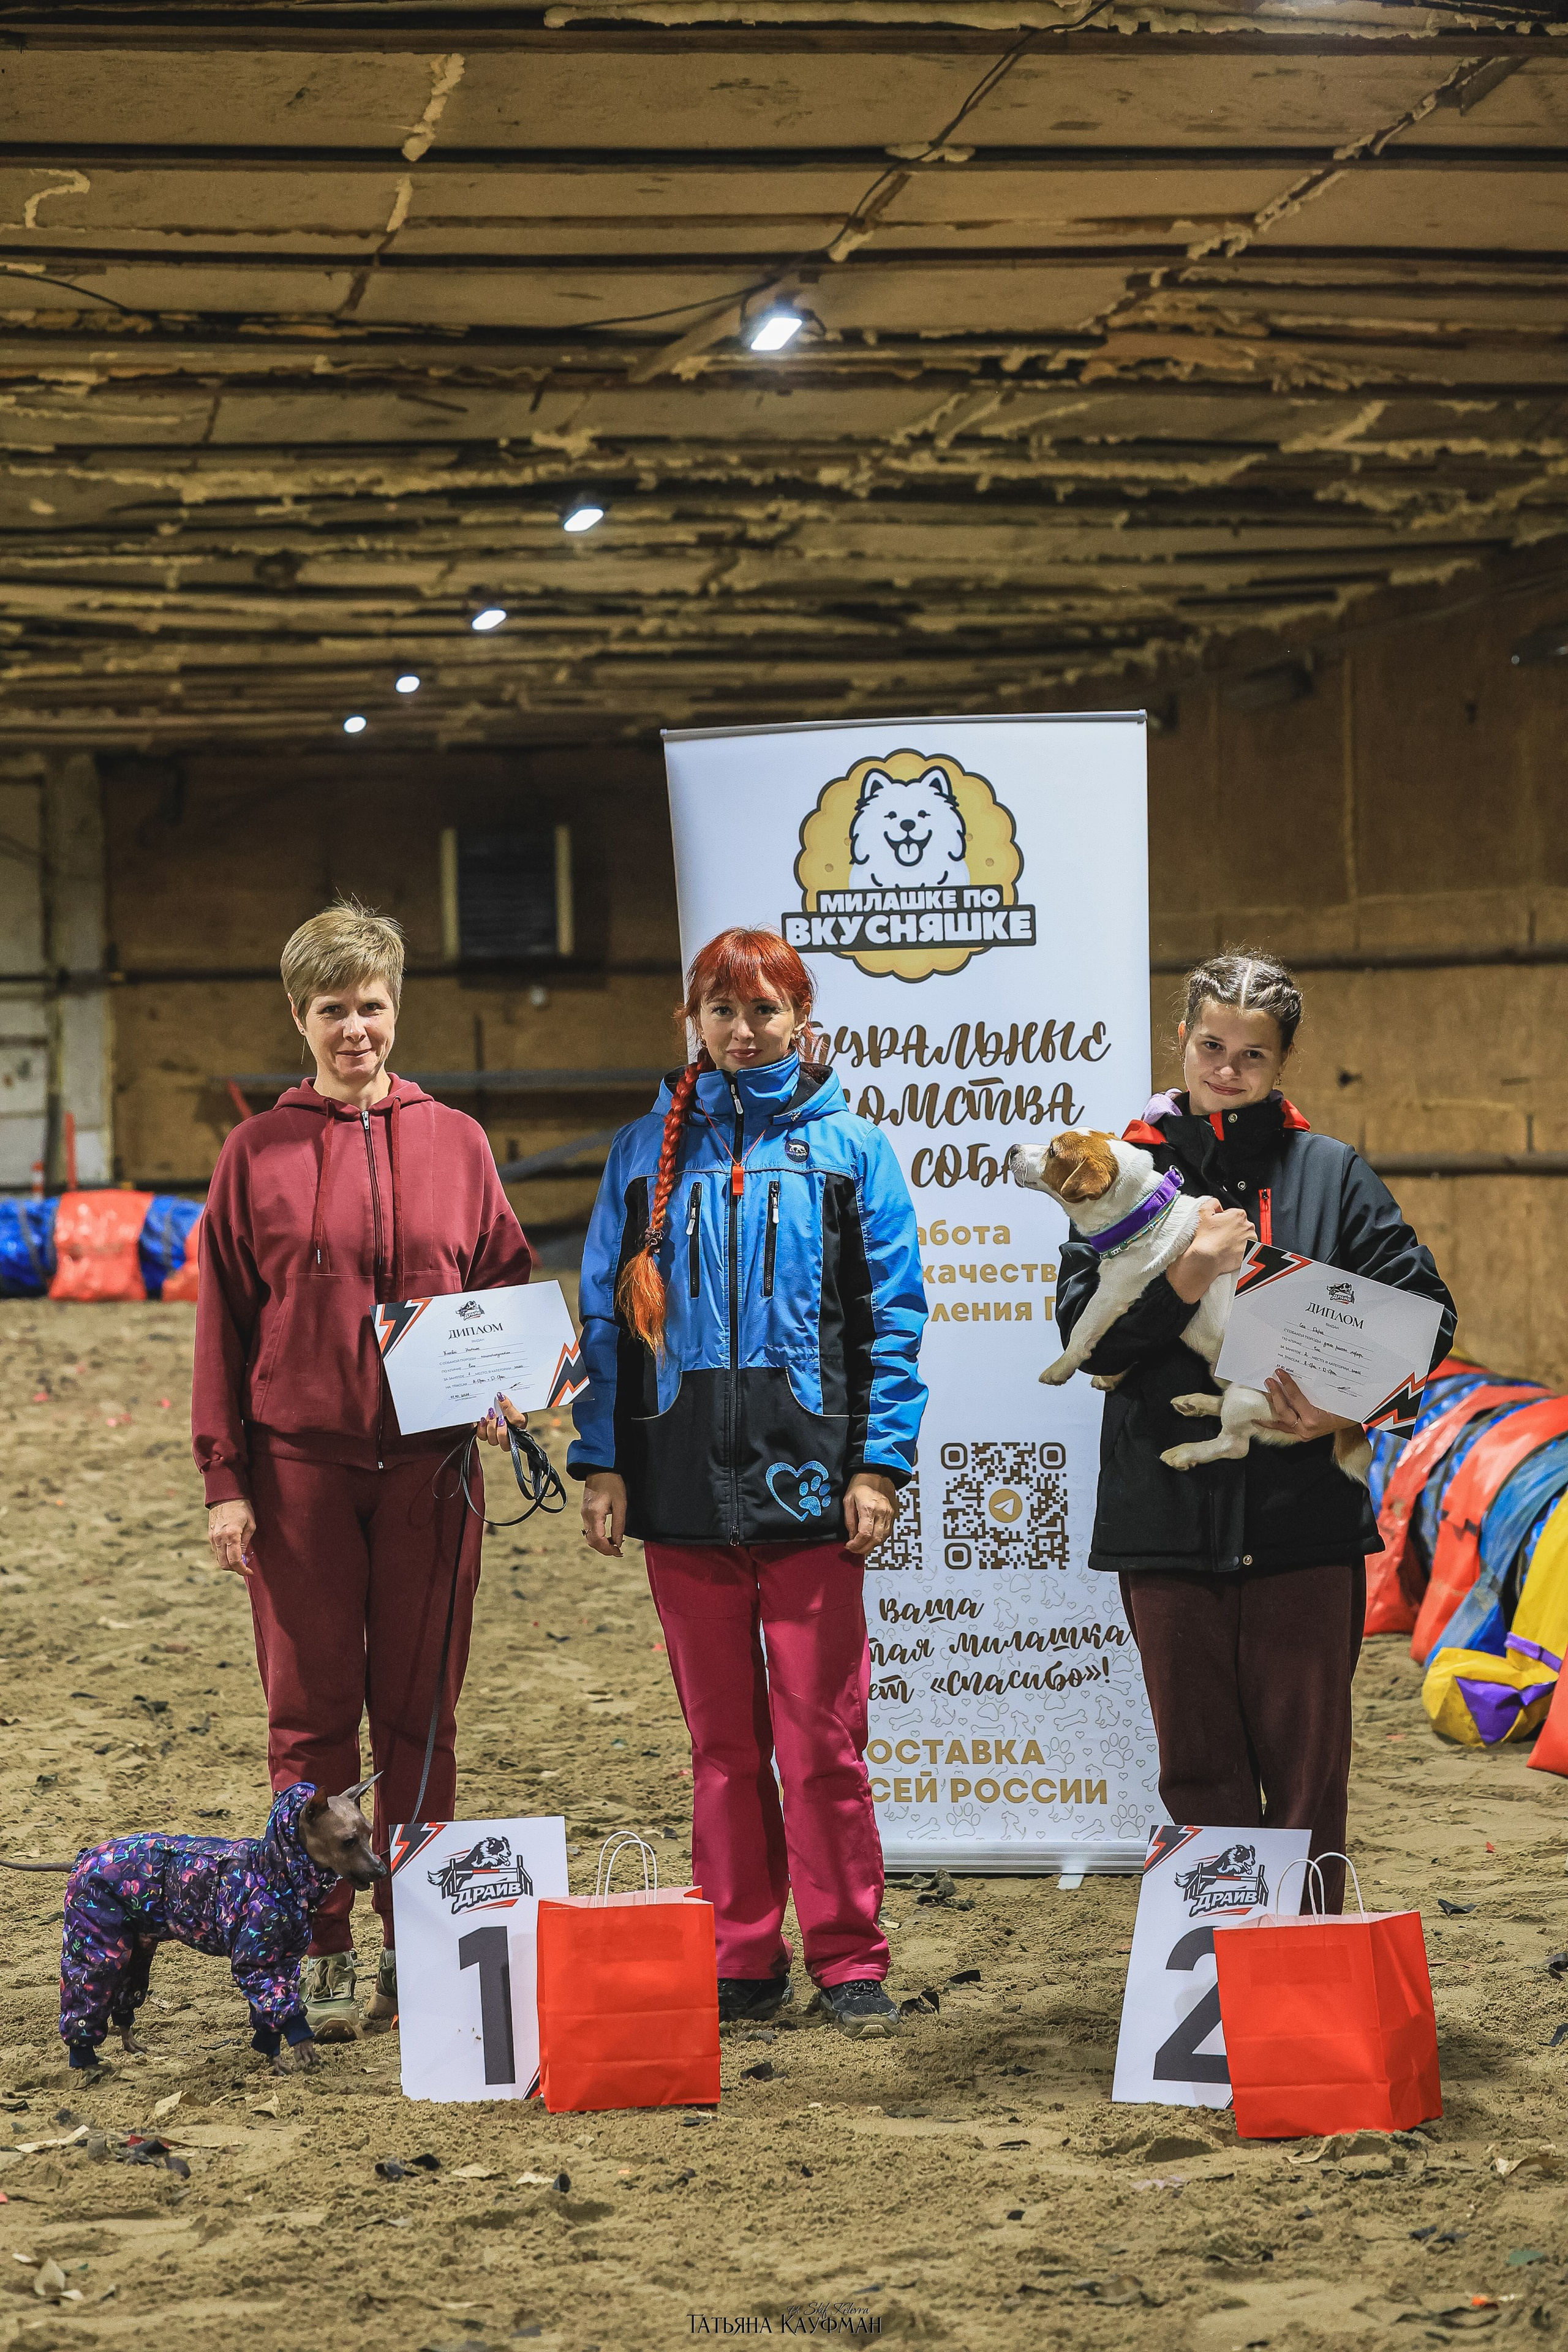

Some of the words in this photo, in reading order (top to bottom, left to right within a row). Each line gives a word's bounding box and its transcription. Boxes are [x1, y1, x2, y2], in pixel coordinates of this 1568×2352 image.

[820, 888, 957, 913] МИЛАШКЕ
[963, 888, 1000, 909] ПО
[785, 910, 1033, 947] ВКУСНЯШКЕ
[930, 1302, 1033, 1322] ления
[1305, 1302, 1364, 1329] ДИПЛОМ
[448, 1323, 504, 1340] ДИПЛОМ
[879, 1598, 984, 1624] Ваша
[949, 1623, 1131, 1657] милашка
[867, 1739, 1045, 1765] ОСТАВКА
[869, 1771, 937, 1803] СЕЙ
[951, 1777, 1107, 1804] РОССИИ
[452, 1878, 523, 1910] ДРАЙВ
[1191, 1886, 1258, 1916] ДРАЙВ
[459, 1926, 516, 2086] 1
[1153, 1926, 1232, 2084] 2
